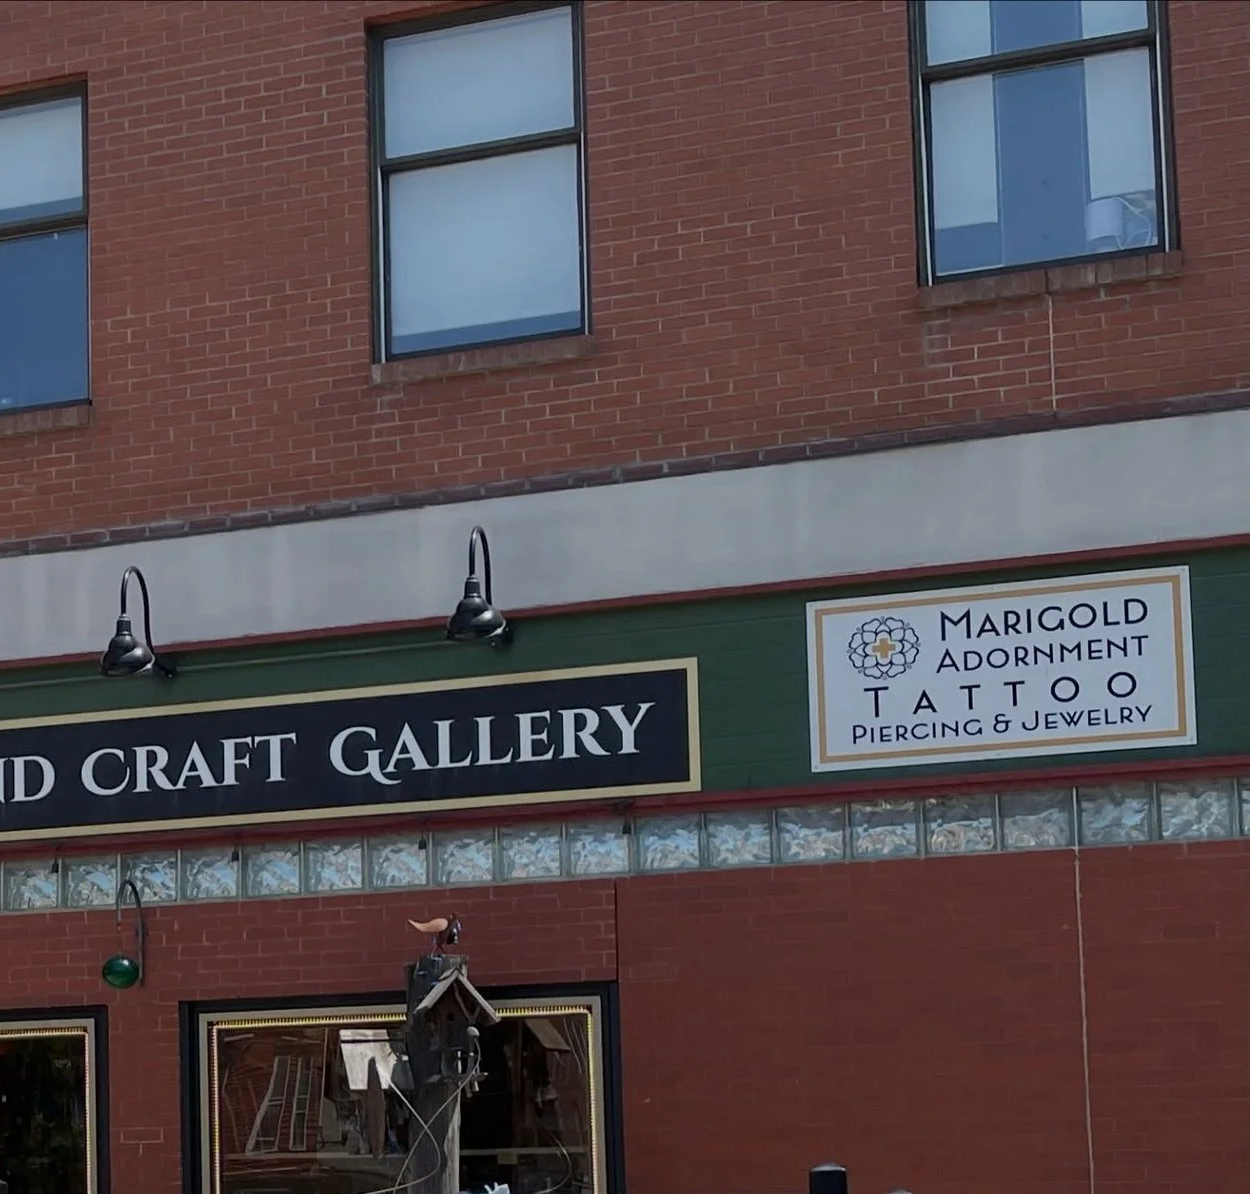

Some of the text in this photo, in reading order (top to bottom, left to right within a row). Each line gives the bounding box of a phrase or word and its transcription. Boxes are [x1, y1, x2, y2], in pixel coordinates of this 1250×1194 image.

[940, 598, 1149, 642] MARIGOLD
[936, 634, 1150, 674] ADORNMENT
[863, 671, 1138, 718] TATTOO
[852, 704, 1152, 745] PIERCING & JEWELRY
[80, 731, 297, 797] CRAFT
[328, 701, 655, 785] GALLERY
